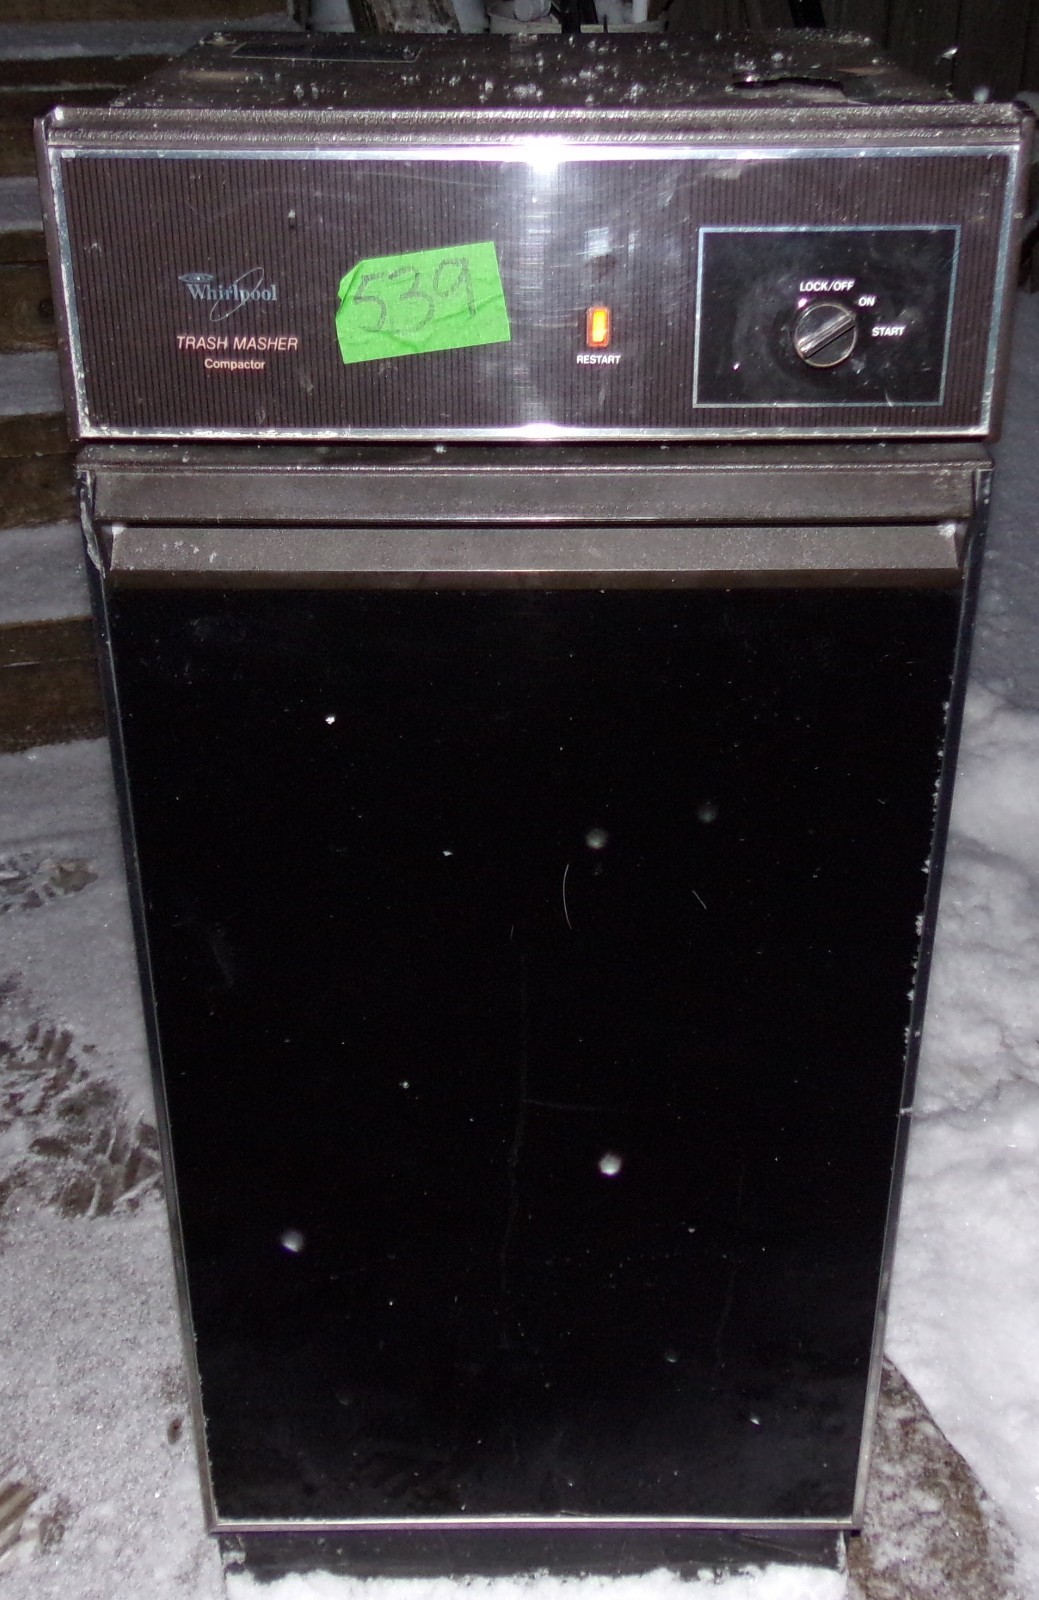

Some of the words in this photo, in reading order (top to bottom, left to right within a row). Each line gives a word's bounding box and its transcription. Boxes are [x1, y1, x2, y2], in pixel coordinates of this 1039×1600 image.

[800, 280, 856, 292] LOCK/OFF
[186, 283, 278, 306] Whirlpool
[354, 257, 476, 333] 539
[858, 296, 877, 307] ON
[872, 326, 906, 337] START
[176, 335, 228, 350] TRASH
[233, 336, 298, 351] MASHER
[204, 358, 266, 371] Compactor
[576, 354, 622, 365] RESTART
